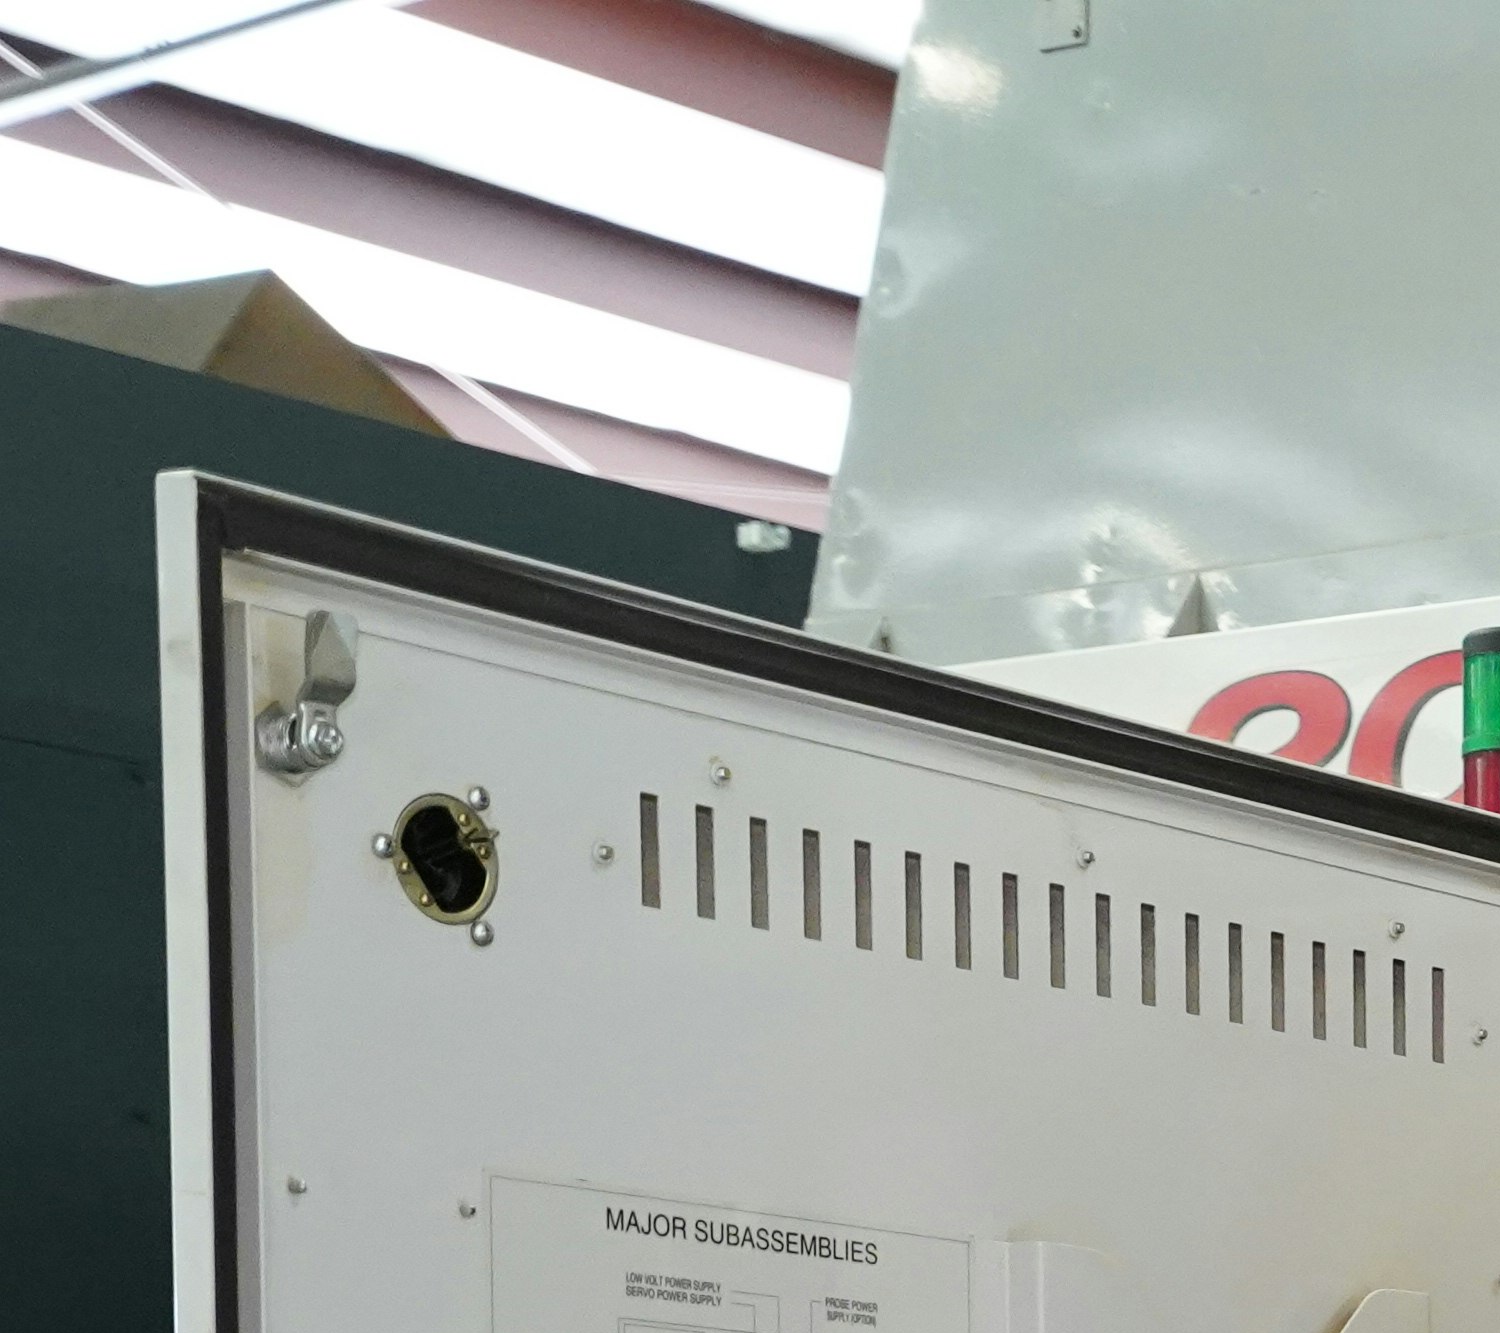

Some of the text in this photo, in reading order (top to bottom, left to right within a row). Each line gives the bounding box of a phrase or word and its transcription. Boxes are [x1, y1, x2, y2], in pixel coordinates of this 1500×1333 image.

[606, 1207, 878, 1265] MAJOR SUBASSEMBLIES
[665, 1276, 691, 1291] POWER
[693, 1279, 721, 1293] SUPPLY
[625, 1285, 722, 1307] SERVO POWER SUPPLY
